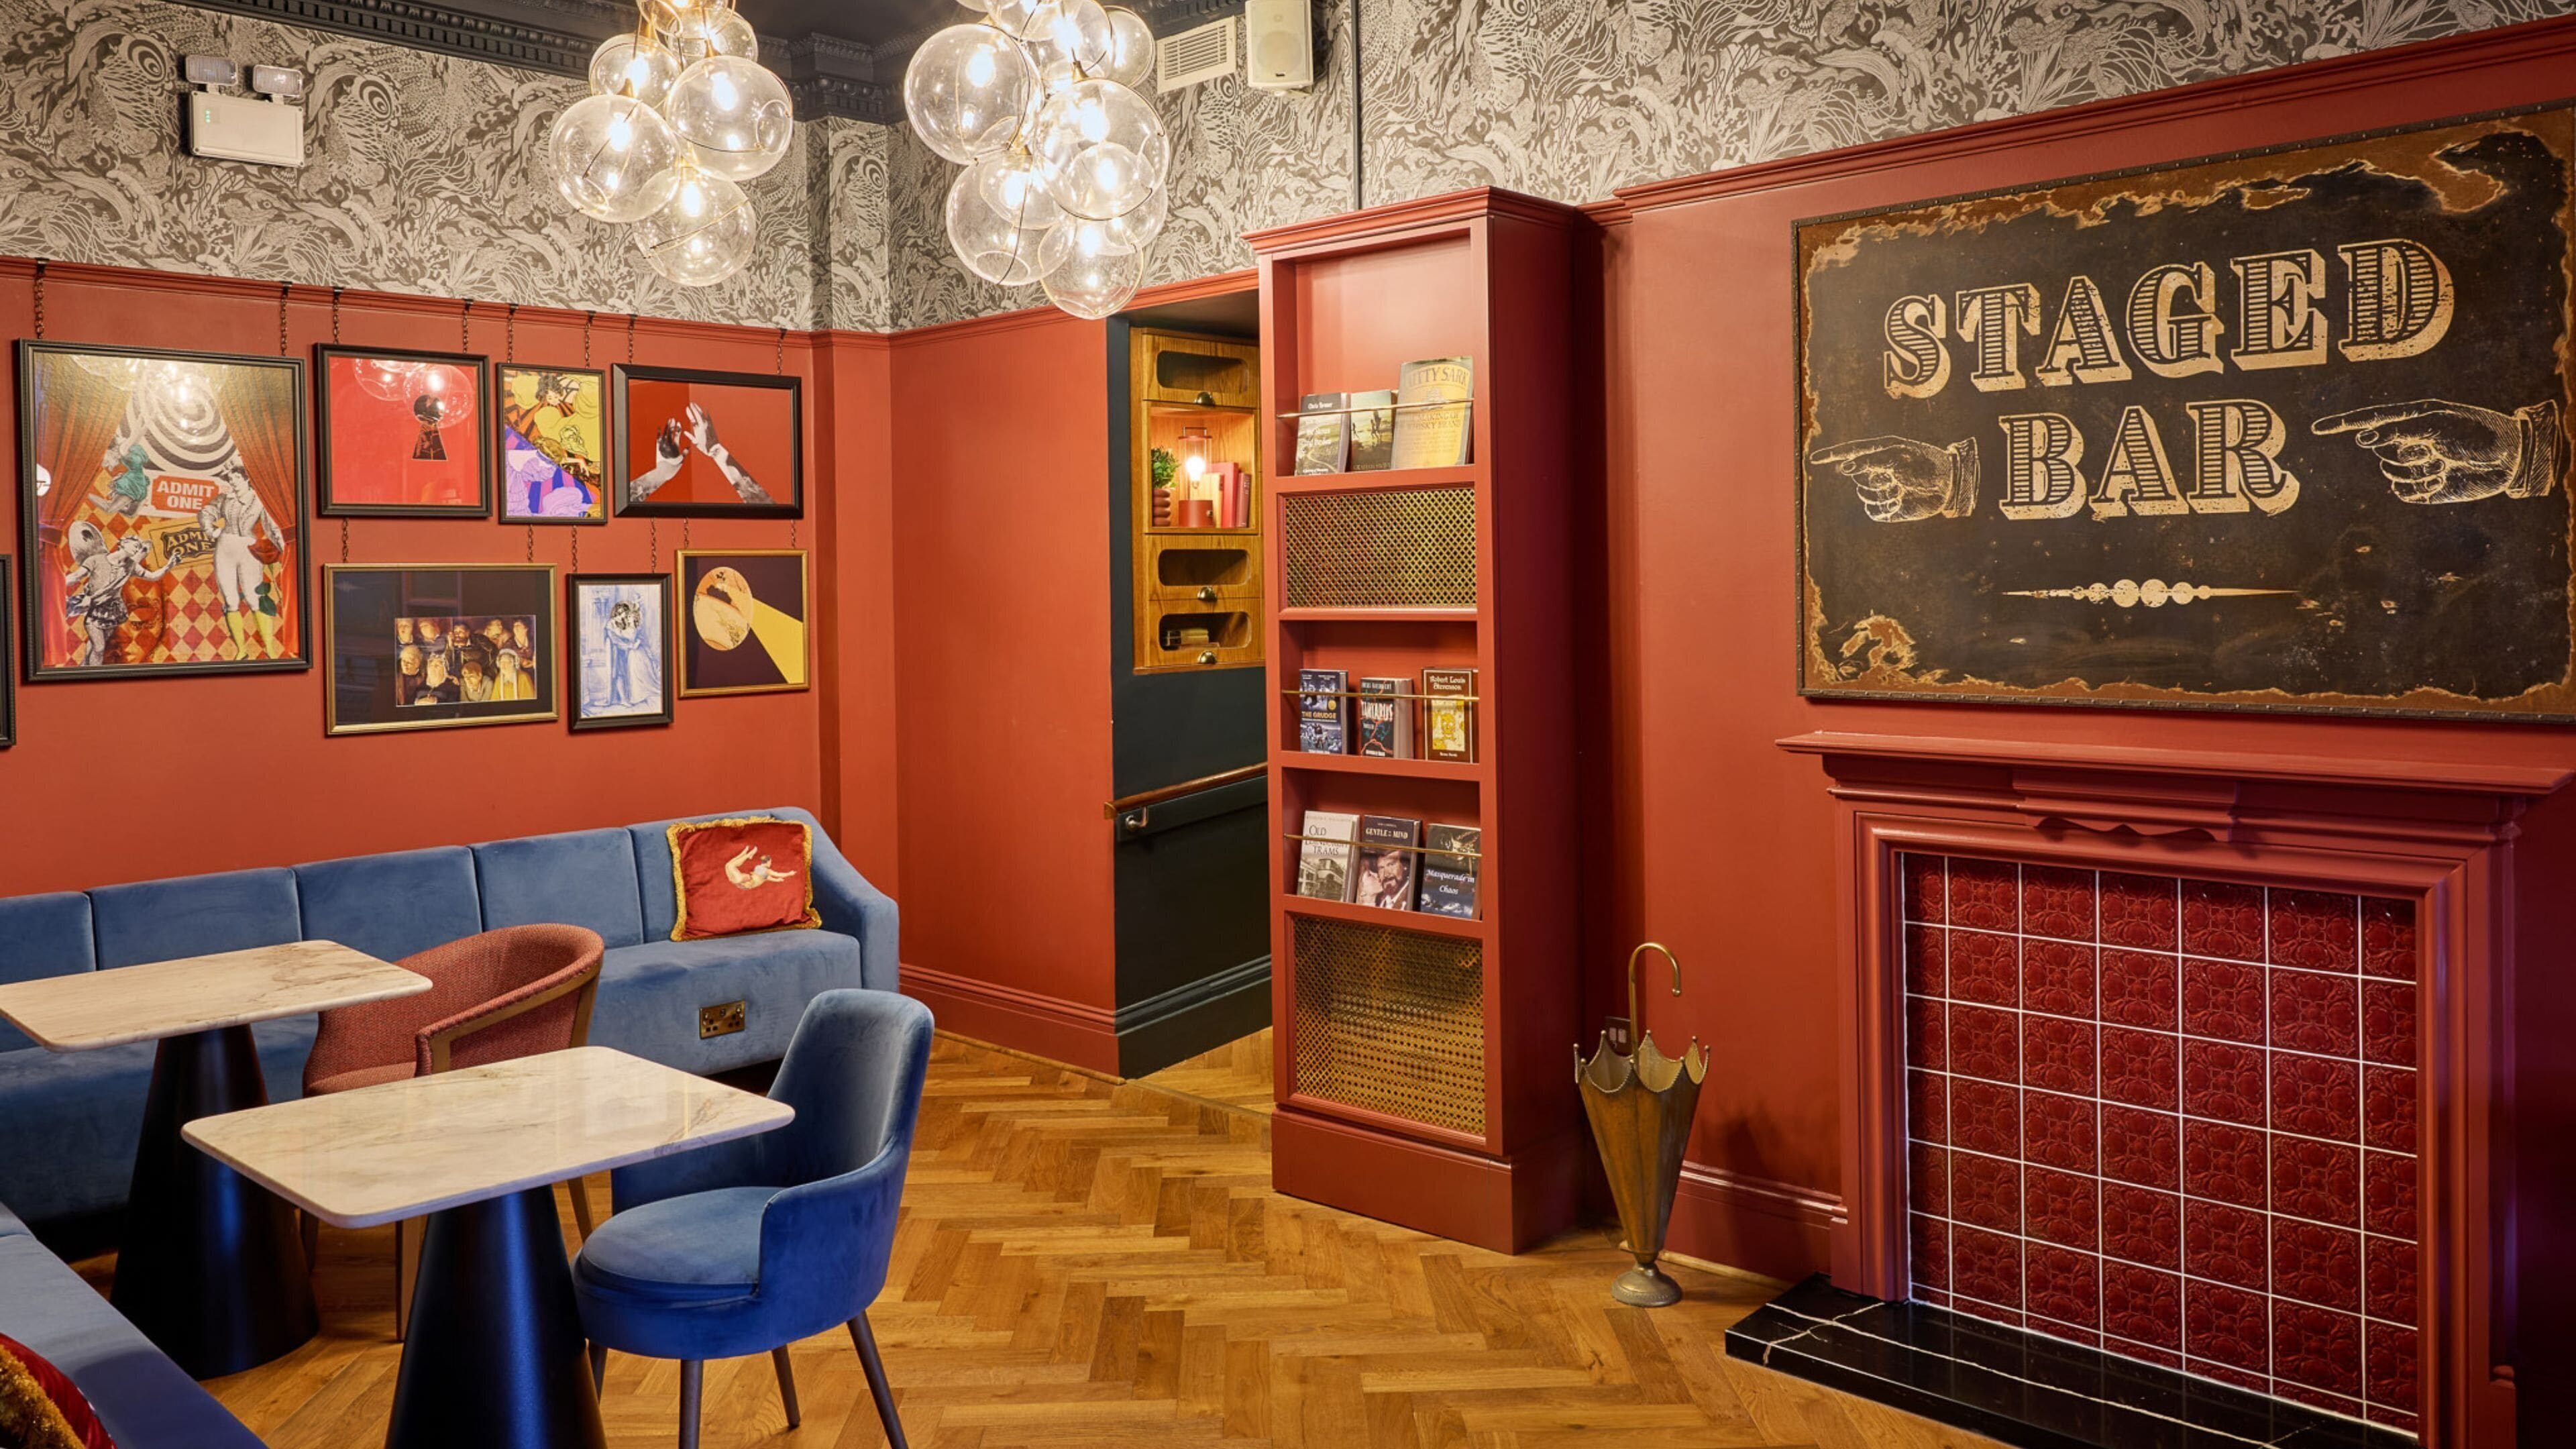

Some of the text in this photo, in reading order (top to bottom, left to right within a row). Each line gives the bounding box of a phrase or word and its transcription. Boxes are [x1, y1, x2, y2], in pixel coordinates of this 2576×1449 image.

[1883, 238, 2455, 400] STAGED
[1404, 366, 1469, 388] UTTY SARK
[1998, 398, 2300, 523] BAR
[156, 480, 215, 497] ADMIT
[166, 495, 203, 511] ONE
[1430, 676, 1466, 684] Robert Louis
[1313, 711, 1337, 720] GRUDGE
[1309, 824, 1327, 836] OLD
[1365, 826, 1388, 837] GENTLE
[1393, 830, 1409, 840] MIND
[1313, 846, 1339, 856] TRAMS
[1426, 869, 1467, 882] Masquerade
[1439, 885, 1458, 895] Chaos
